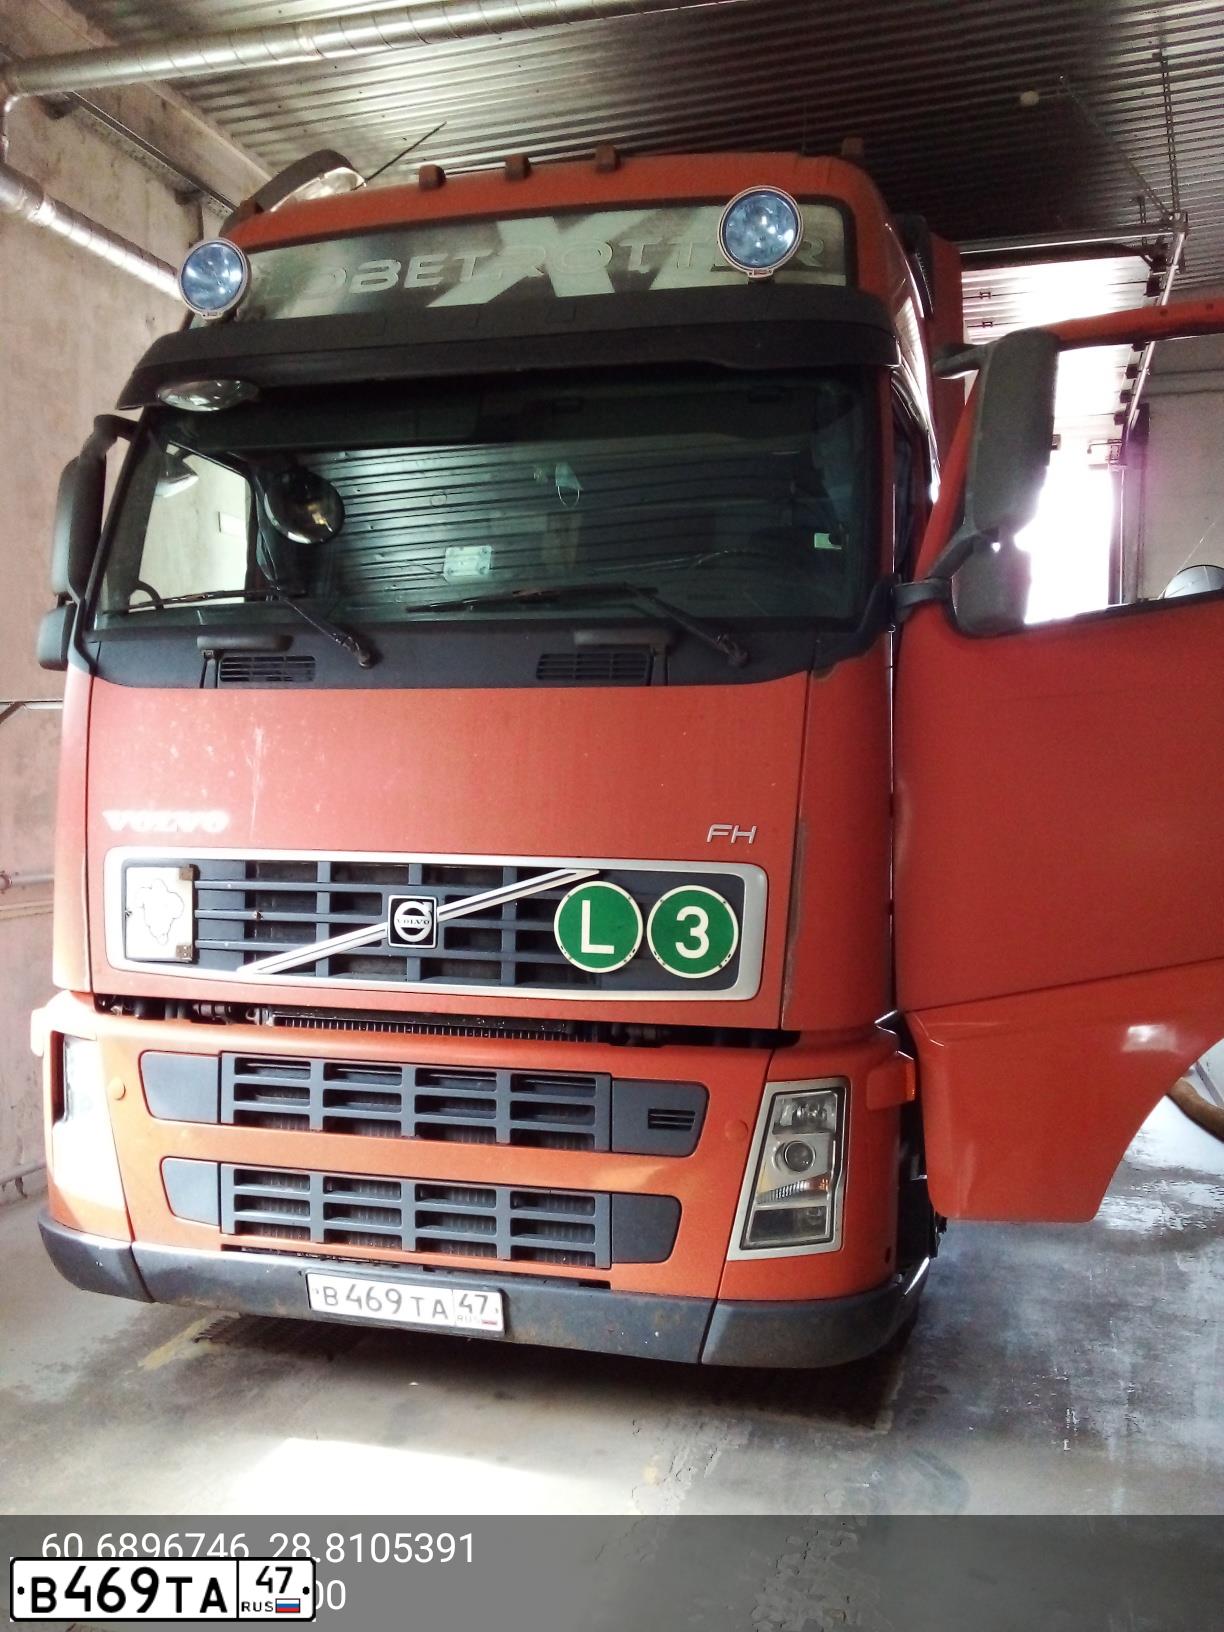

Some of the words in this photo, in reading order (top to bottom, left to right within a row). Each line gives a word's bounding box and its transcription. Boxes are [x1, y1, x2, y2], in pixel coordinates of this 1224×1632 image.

[706, 823, 757, 844] FH
[581, 899, 615, 954] L
[675, 905, 710, 959] 3
[458, 1293, 488, 1315] 47
